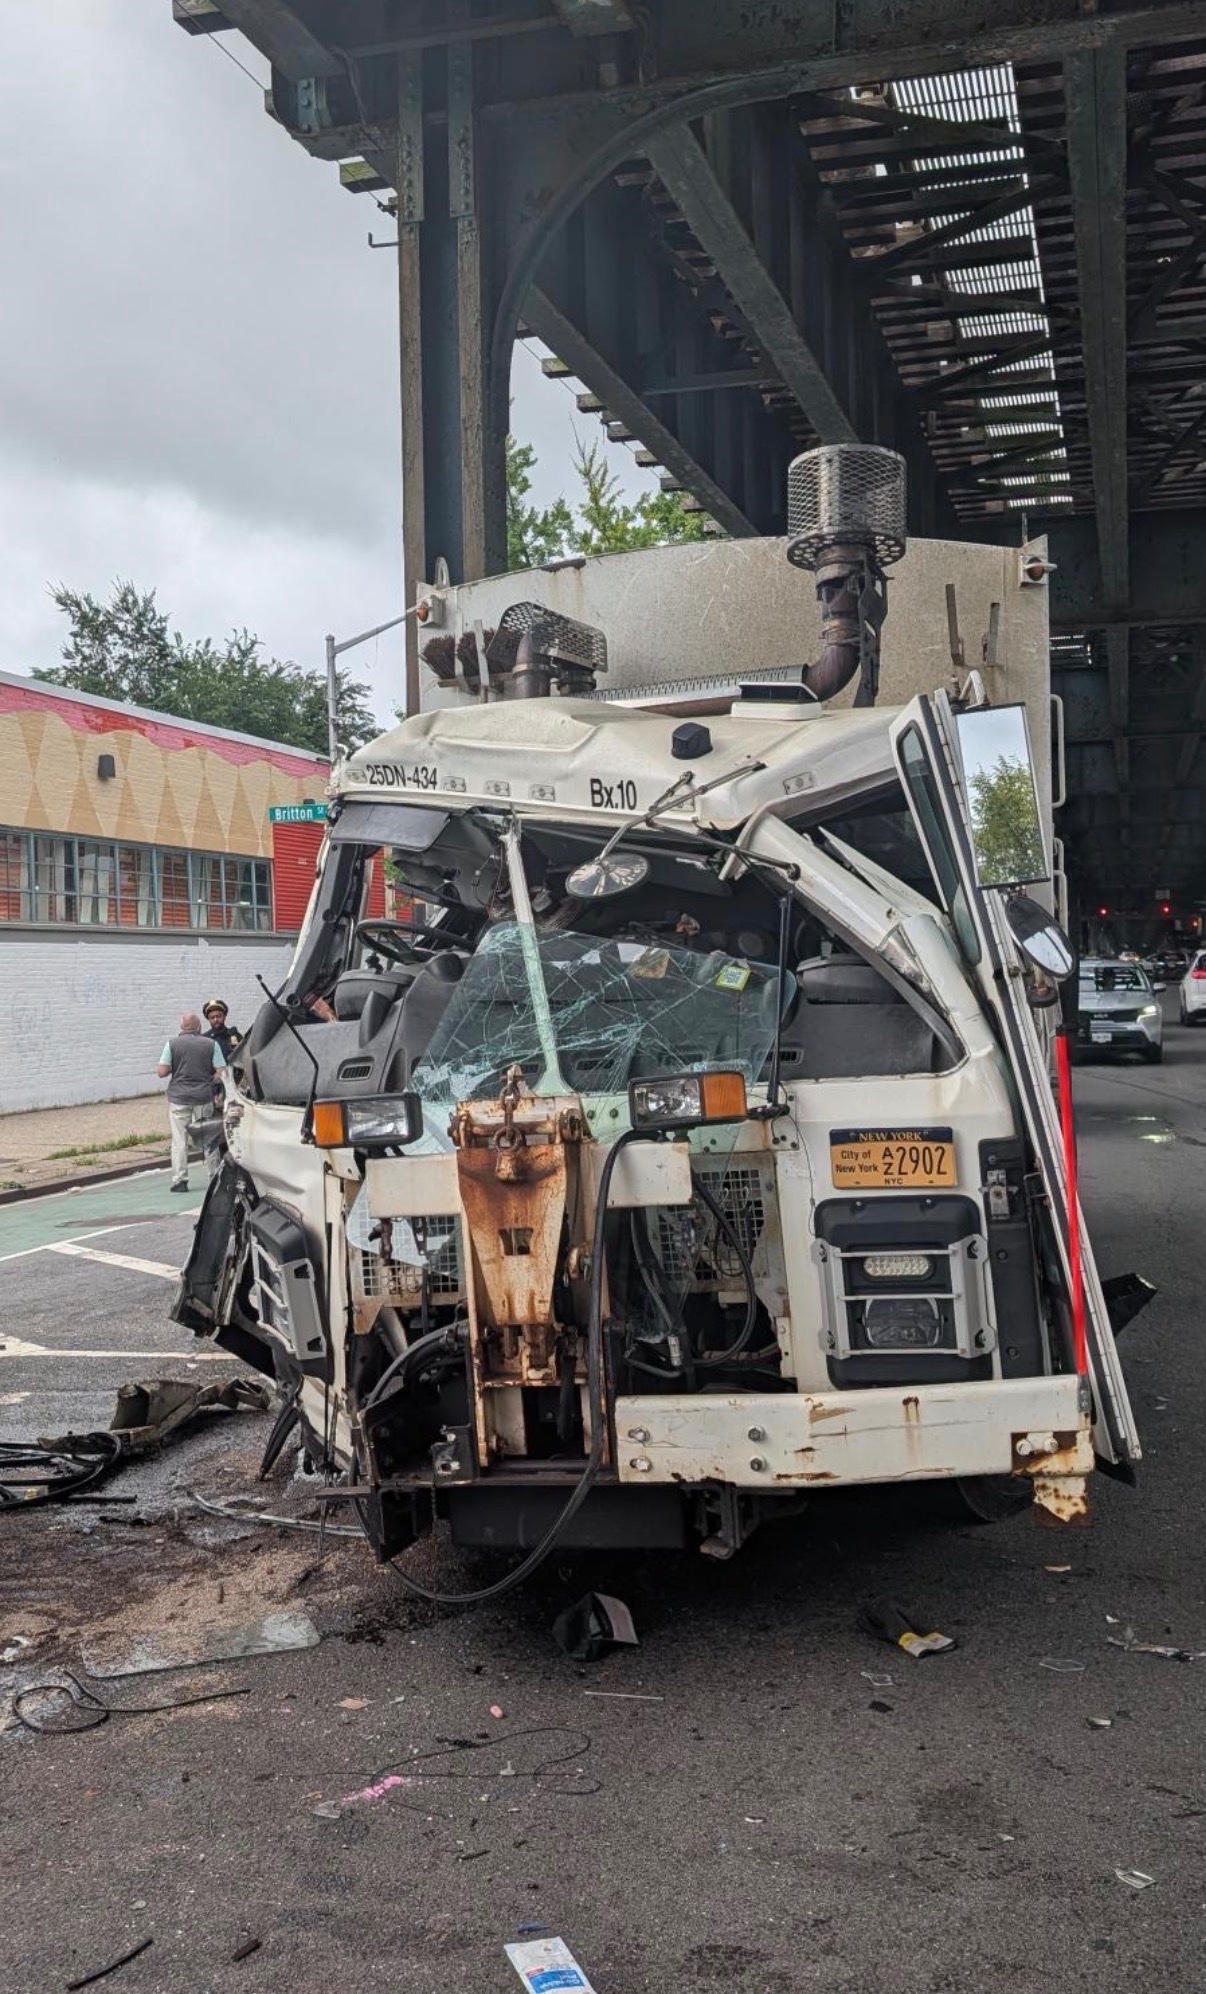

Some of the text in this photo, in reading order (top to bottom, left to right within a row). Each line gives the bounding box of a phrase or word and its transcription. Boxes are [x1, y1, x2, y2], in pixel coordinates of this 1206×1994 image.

[367, 764, 437, 790] 25DN-434
[590, 778, 637, 811] Bx.10
[275, 806, 325, 821] Britton St
[860, 1131, 922, 1141] NEW YORK
[841, 1149, 871, 1161] City of
[896, 1146, 947, 1176] 2902
[836, 1163, 879, 1173] New York
